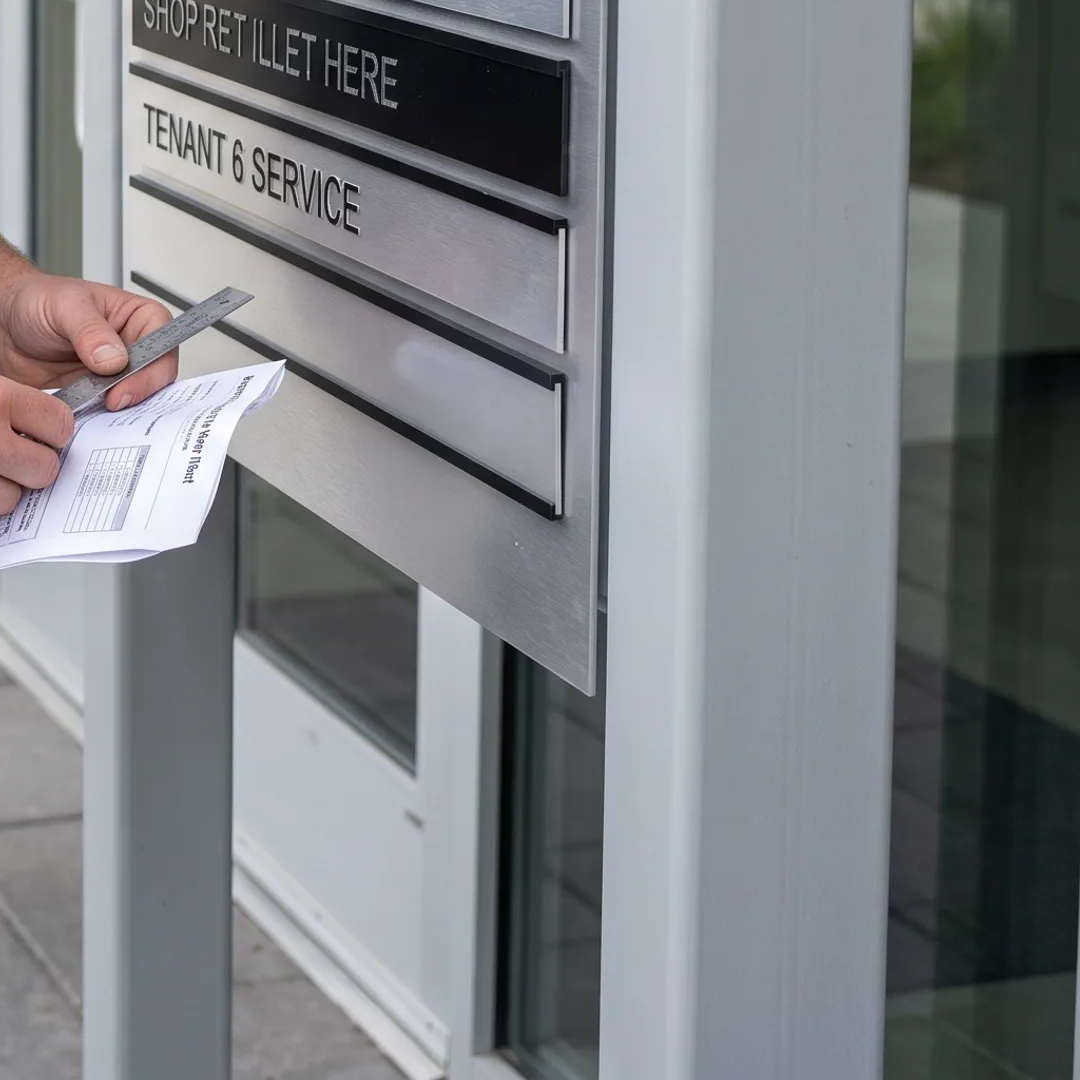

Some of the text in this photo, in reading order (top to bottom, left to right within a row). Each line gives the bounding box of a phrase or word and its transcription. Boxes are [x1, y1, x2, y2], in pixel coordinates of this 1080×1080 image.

[324, 38, 398, 110] HERE
[143, 103, 361, 236] TENANT 6 SERVICE
